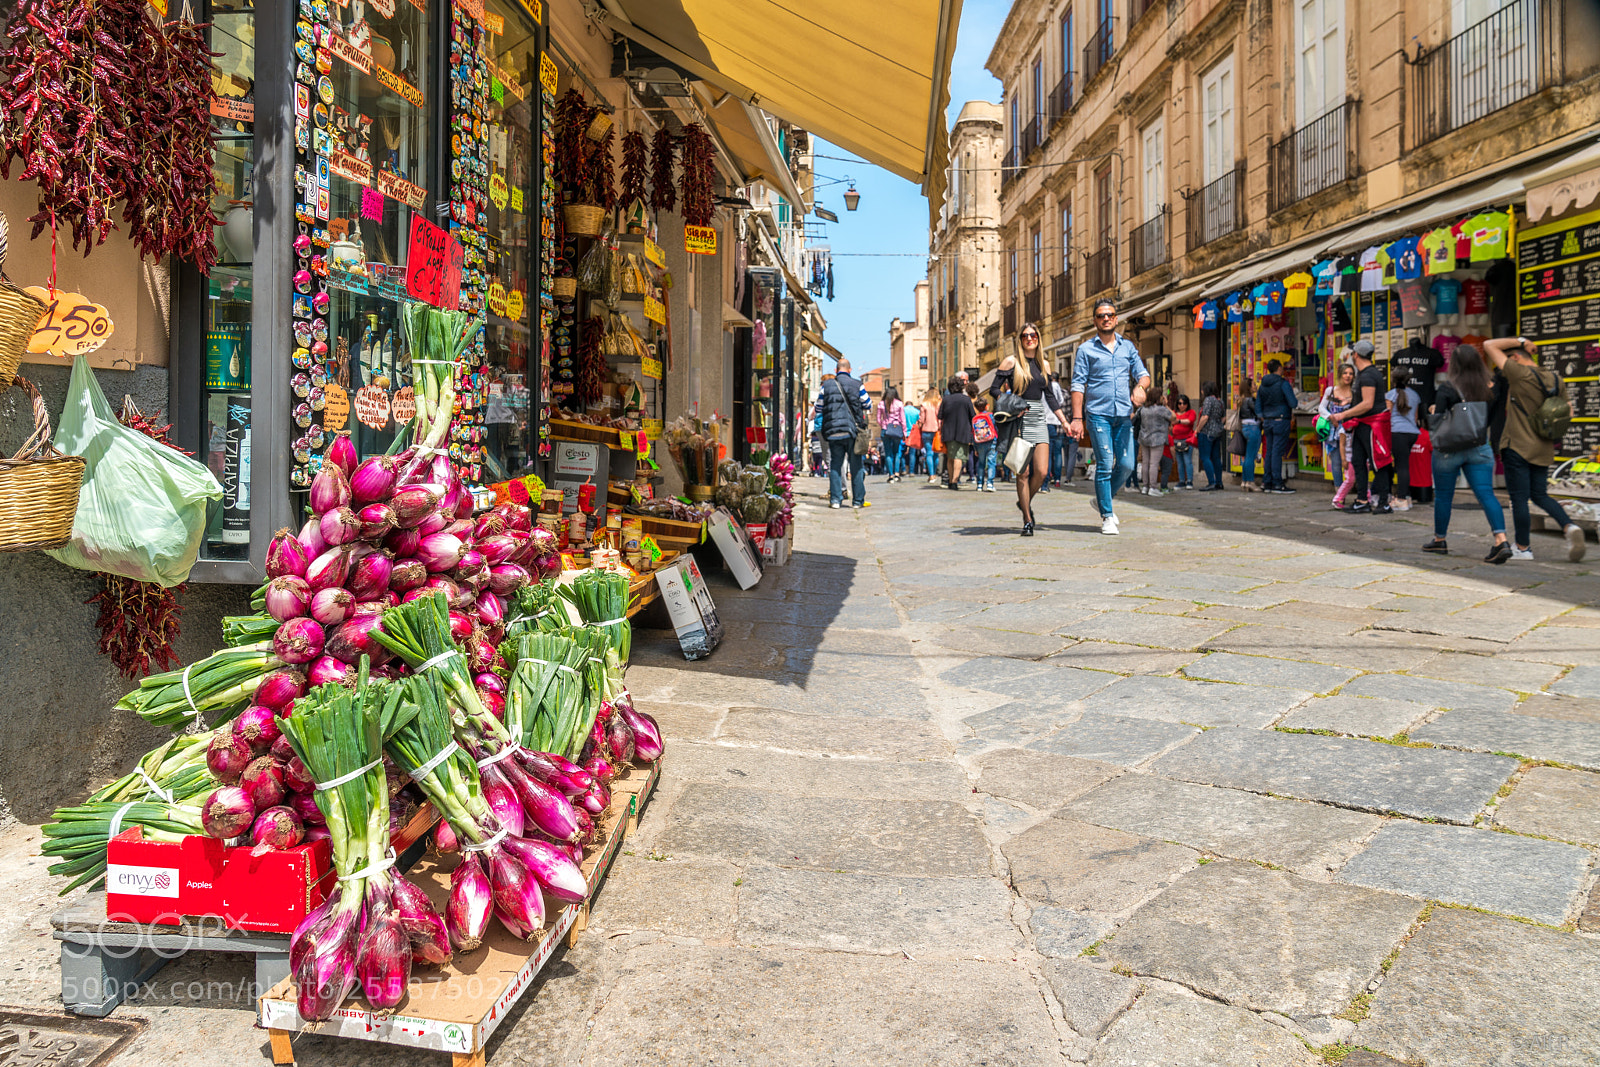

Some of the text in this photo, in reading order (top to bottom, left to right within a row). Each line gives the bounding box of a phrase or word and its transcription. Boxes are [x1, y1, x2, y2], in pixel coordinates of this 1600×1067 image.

[223, 427, 239, 510] GRAPPIZIA
[119, 871, 155, 893] envy
[186, 880, 213, 889] Apples
